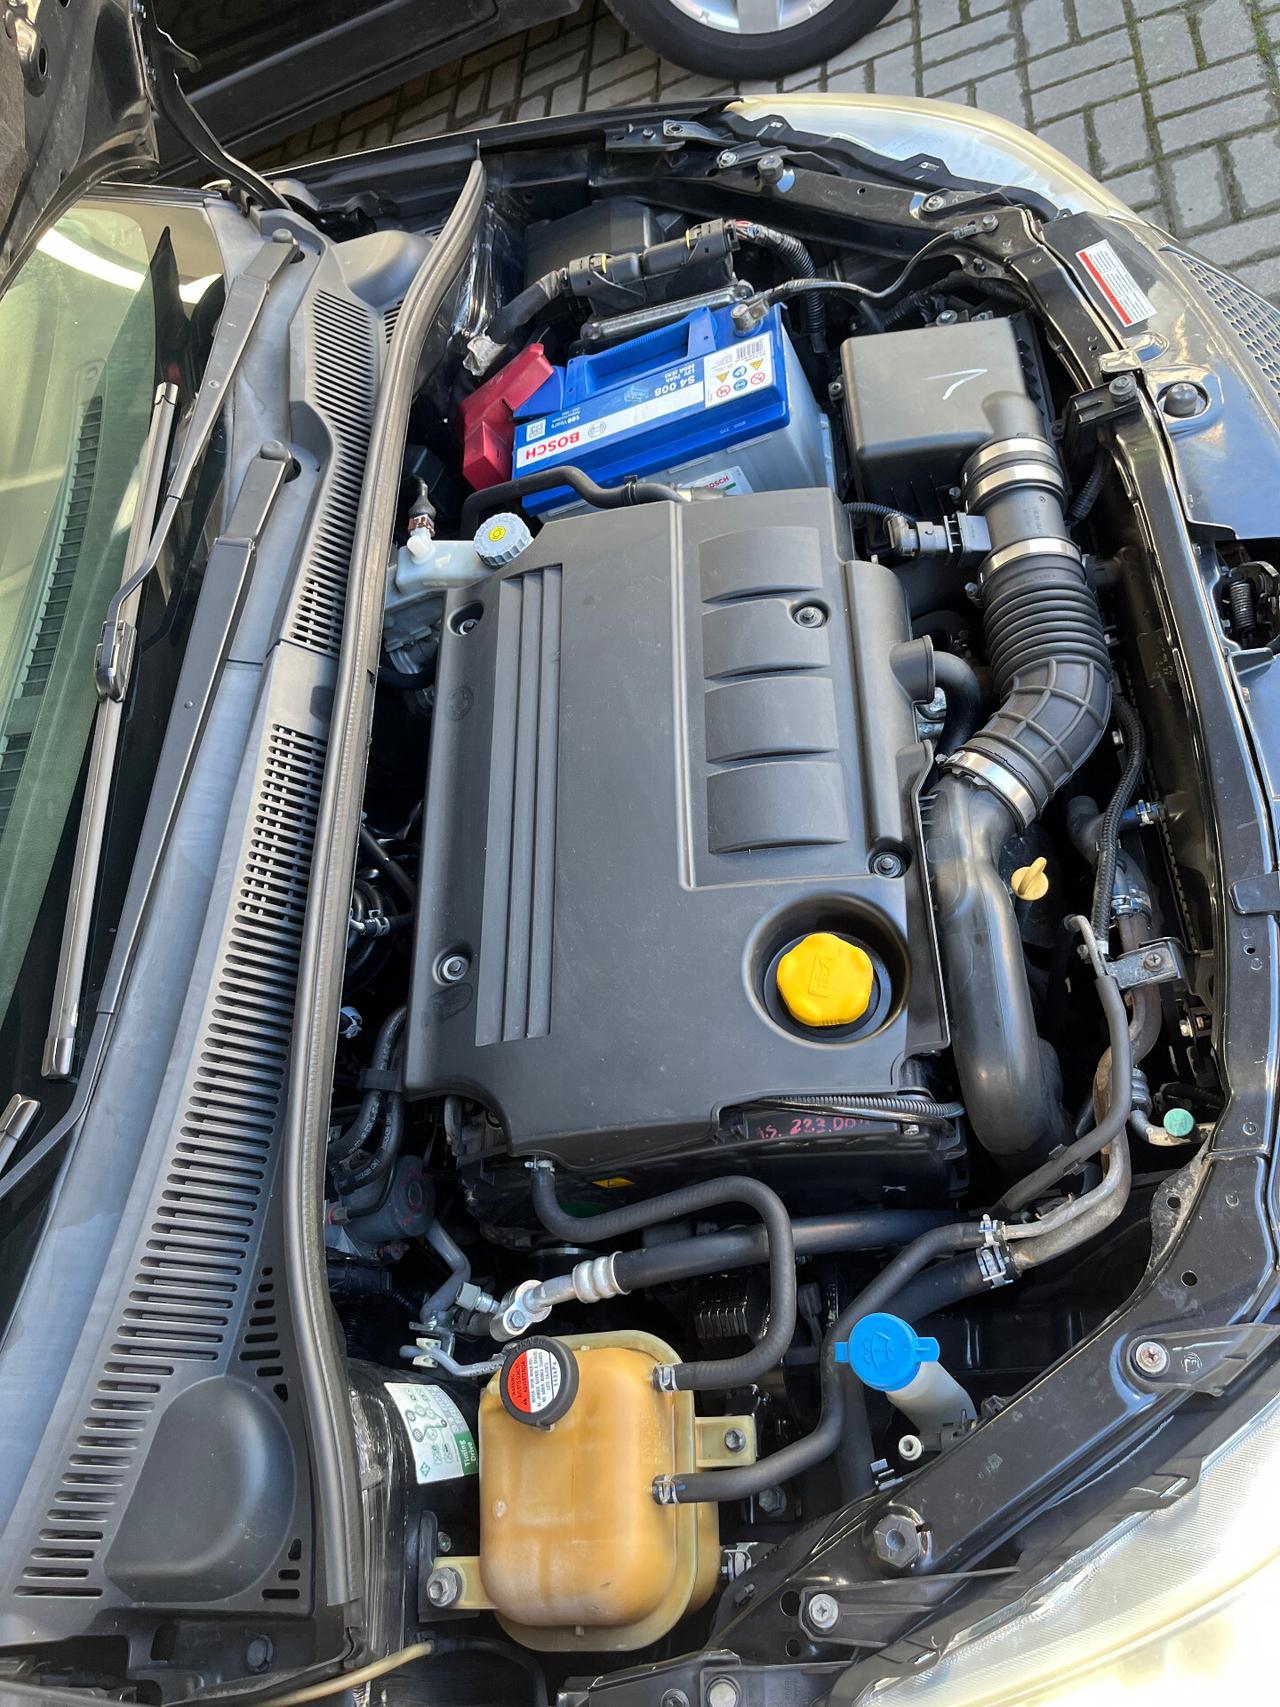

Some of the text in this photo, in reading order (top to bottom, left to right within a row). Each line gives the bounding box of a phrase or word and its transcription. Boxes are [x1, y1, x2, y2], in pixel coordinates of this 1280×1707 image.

[654, 375, 695, 397] S4 008
[525, 431, 580, 460] BOSCH
[459, 1439, 471, 1468] Timing
